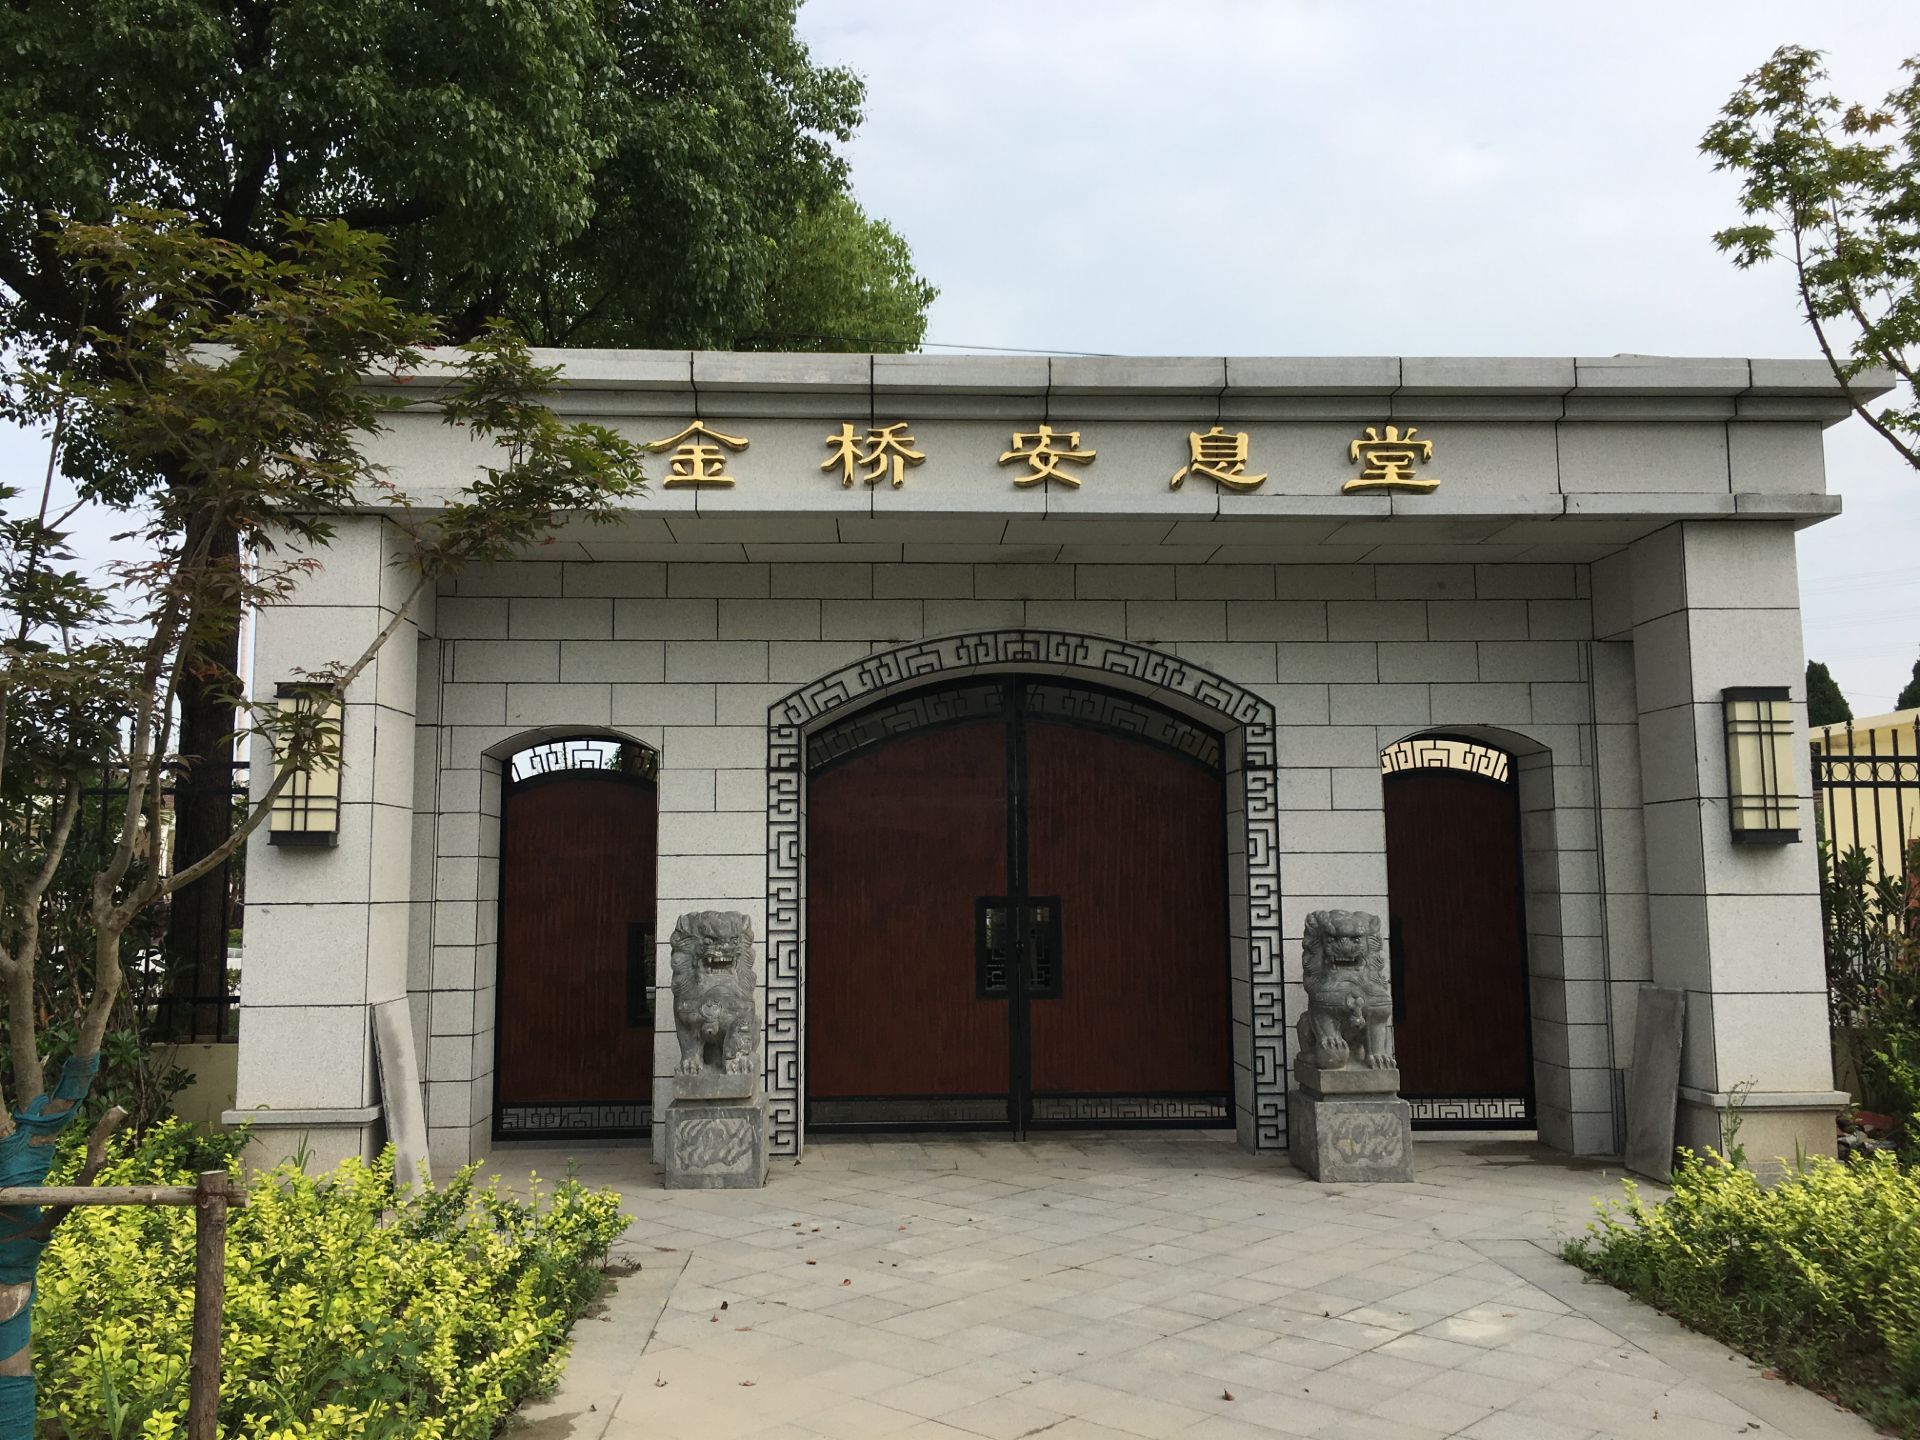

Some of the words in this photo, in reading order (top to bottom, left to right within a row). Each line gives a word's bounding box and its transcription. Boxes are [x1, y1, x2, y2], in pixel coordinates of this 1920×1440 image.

[648, 419, 1441, 493] 金桥安息堂
